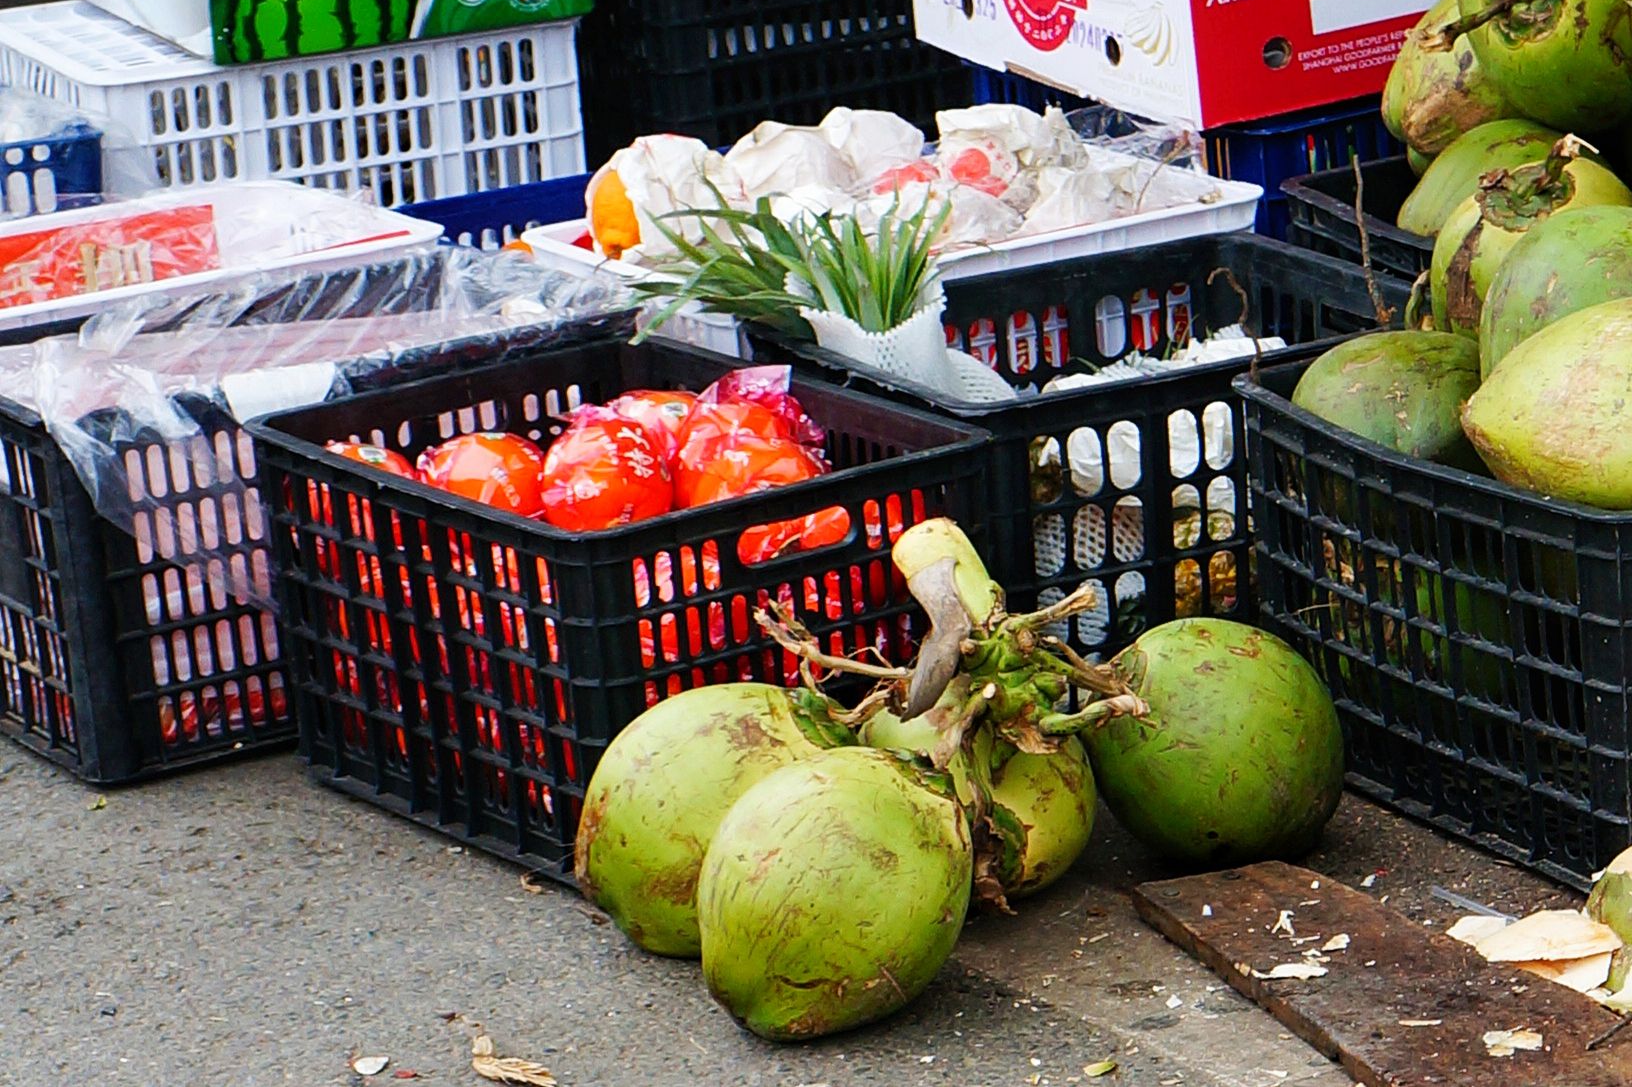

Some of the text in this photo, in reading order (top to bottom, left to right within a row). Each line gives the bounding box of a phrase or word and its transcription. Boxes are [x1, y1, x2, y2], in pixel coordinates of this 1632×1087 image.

[1298, 48, 1326, 61] EXPORT
[1328, 44, 1340, 54] TO
[1340, 41, 1354, 52] THE
[1302, 43, 1396, 71] SHANGHAI GOODFARMER
